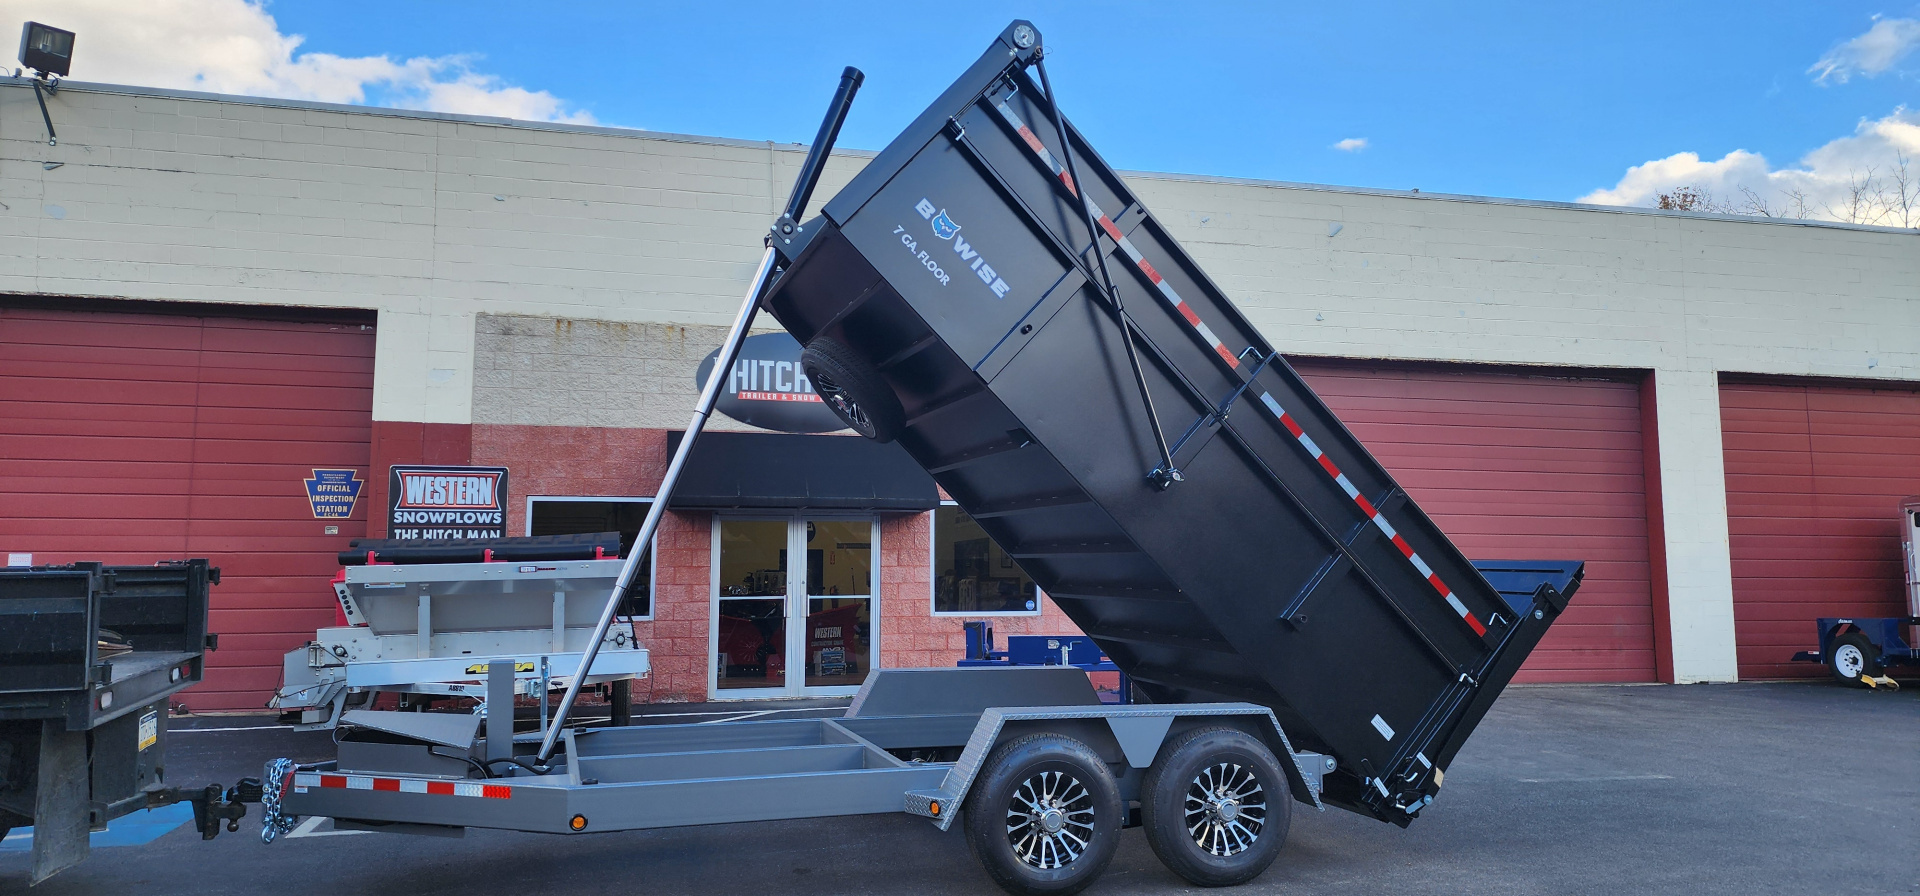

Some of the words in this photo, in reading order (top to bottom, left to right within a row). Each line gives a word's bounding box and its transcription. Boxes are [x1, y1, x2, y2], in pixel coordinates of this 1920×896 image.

[893, 224, 905, 234] 7
[901, 233, 917, 255] GA.
[917, 250, 950, 286] FLOOR
[741, 392, 777, 400] TRAILER
[317, 484, 351, 492] OFFICIAL
[405, 475, 493, 505] WESTERN
[316, 505, 348, 513] STATION
[393, 512, 502, 524] SNOWPLOWS
[394, 529, 419, 540] THE
[423, 529, 463, 540] HITCH
[814, 627, 842, 638] WESTERN
